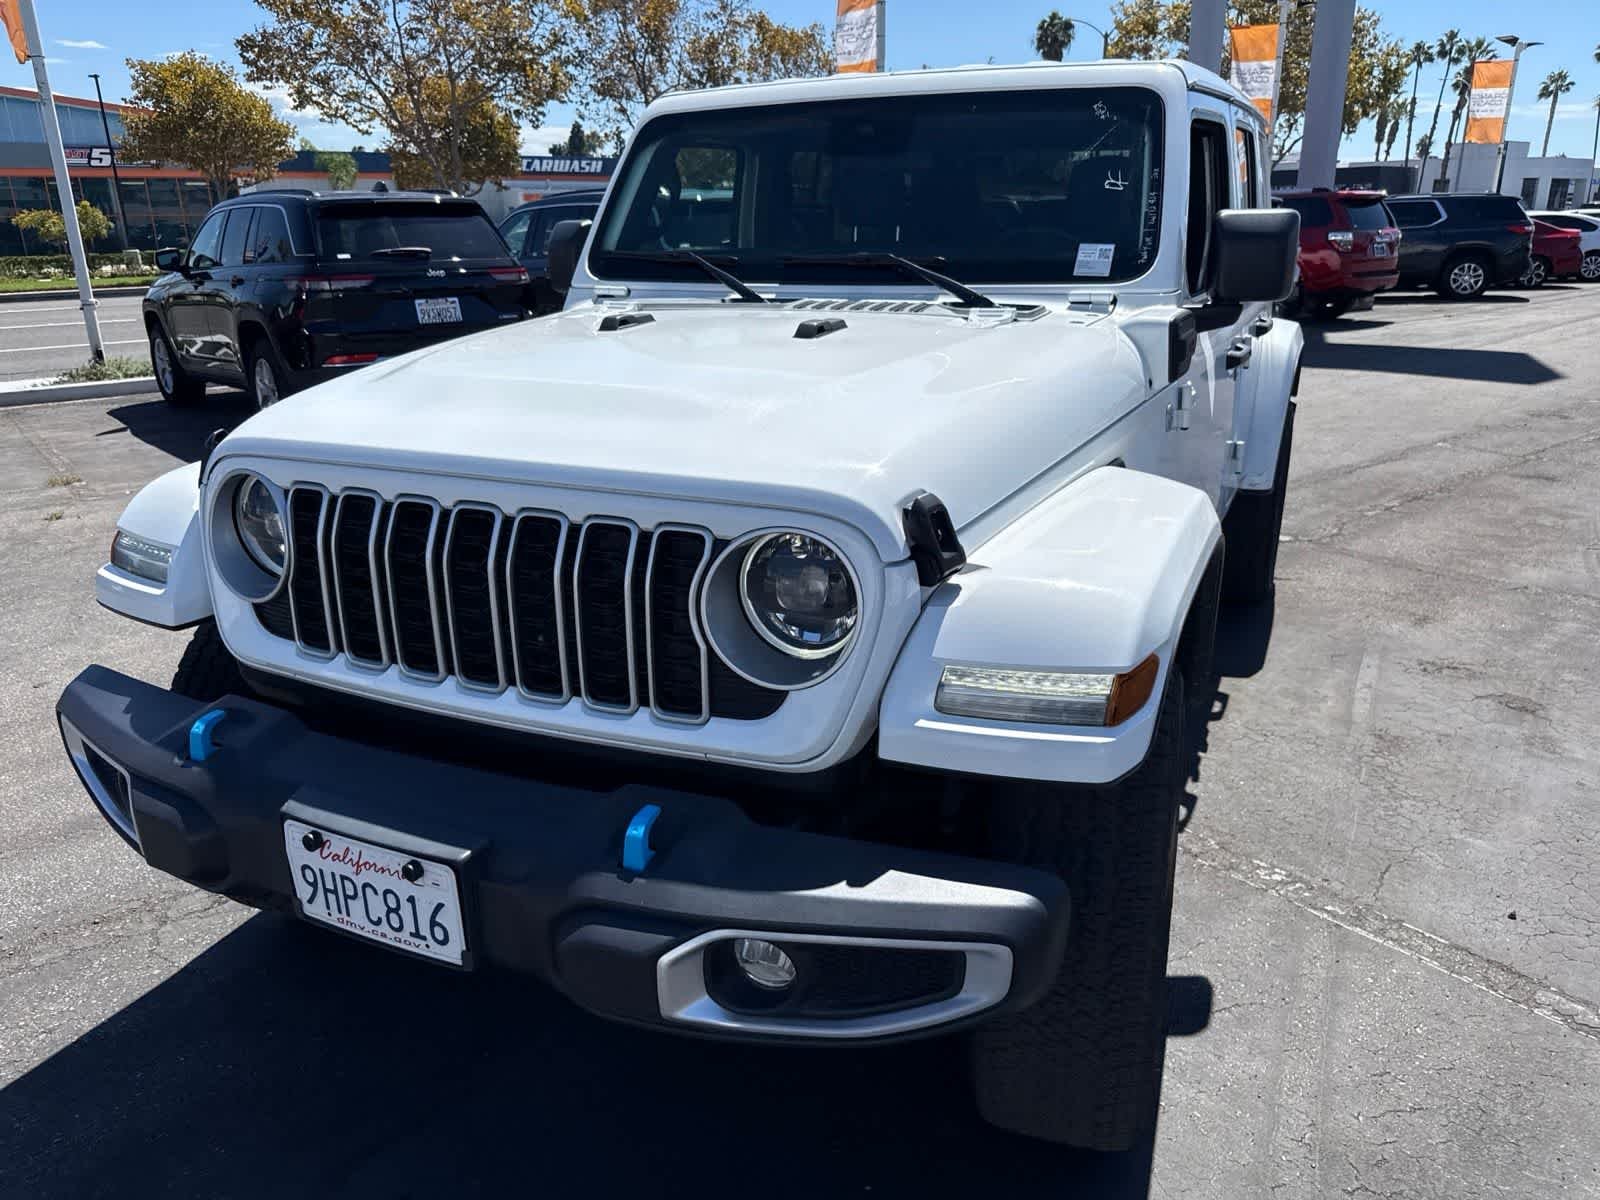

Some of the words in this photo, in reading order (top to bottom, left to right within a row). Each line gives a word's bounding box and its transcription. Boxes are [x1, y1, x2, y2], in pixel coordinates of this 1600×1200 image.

[89, 147, 112, 167] 5
[522, 158, 603, 173] CARWASH
[426, 268, 446, 278] Jeep
[319, 839, 414, 881] Californi
[301, 864, 450, 946] 9HPC816
